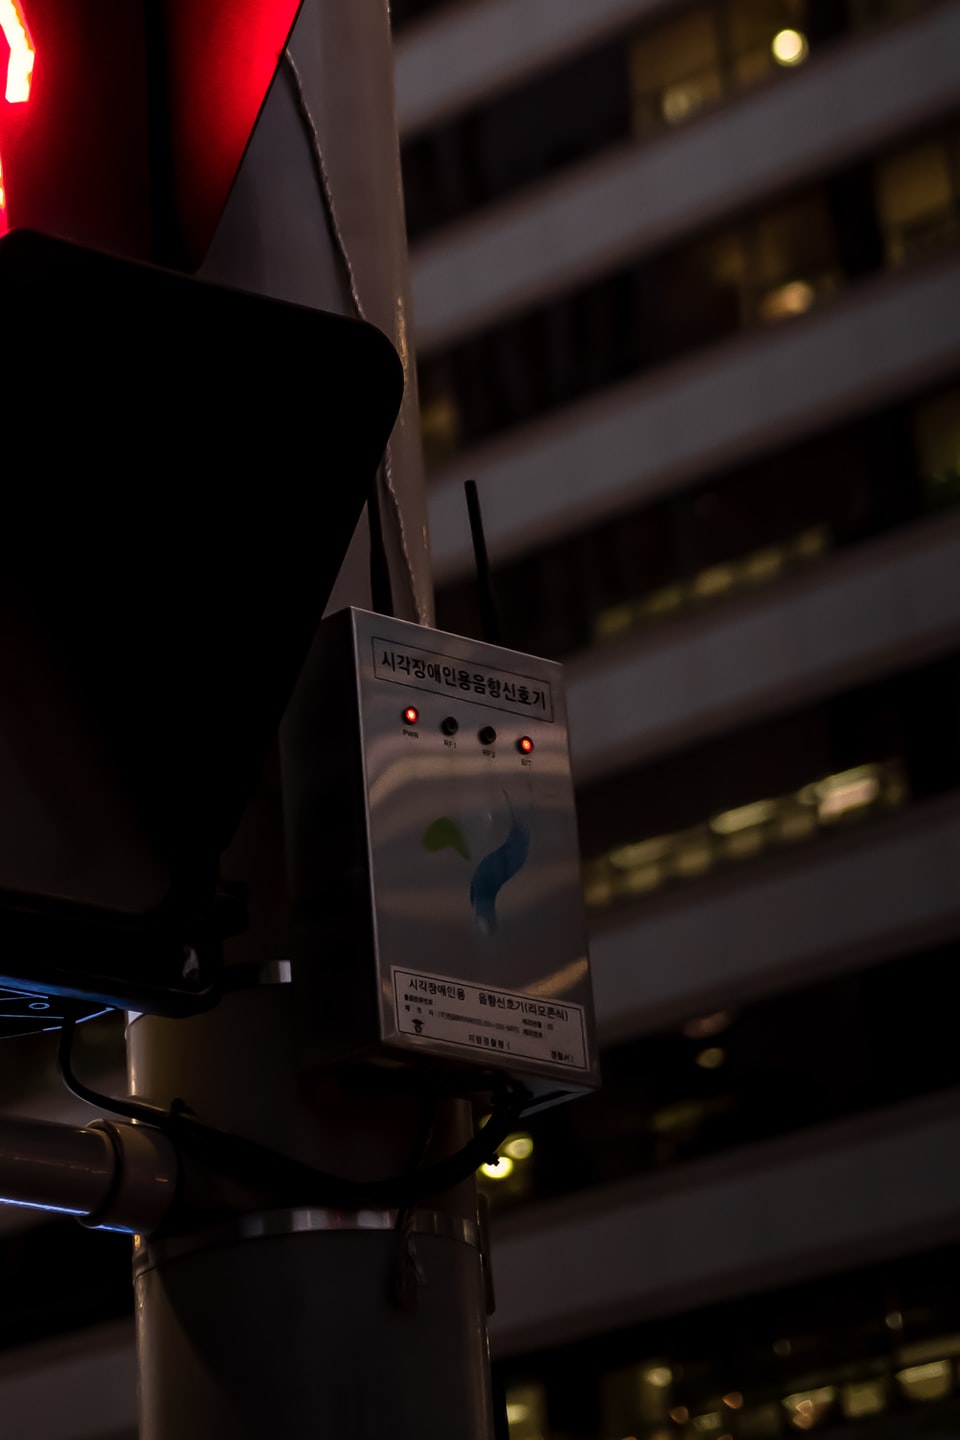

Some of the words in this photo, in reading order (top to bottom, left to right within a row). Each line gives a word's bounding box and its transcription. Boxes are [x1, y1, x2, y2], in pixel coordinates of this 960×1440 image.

[382, 651, 546, 710] 시각장애인용음향신호기
[402, 729, 419, 739] PWR
[409, 978, 465, 1001] 시각장애인용
